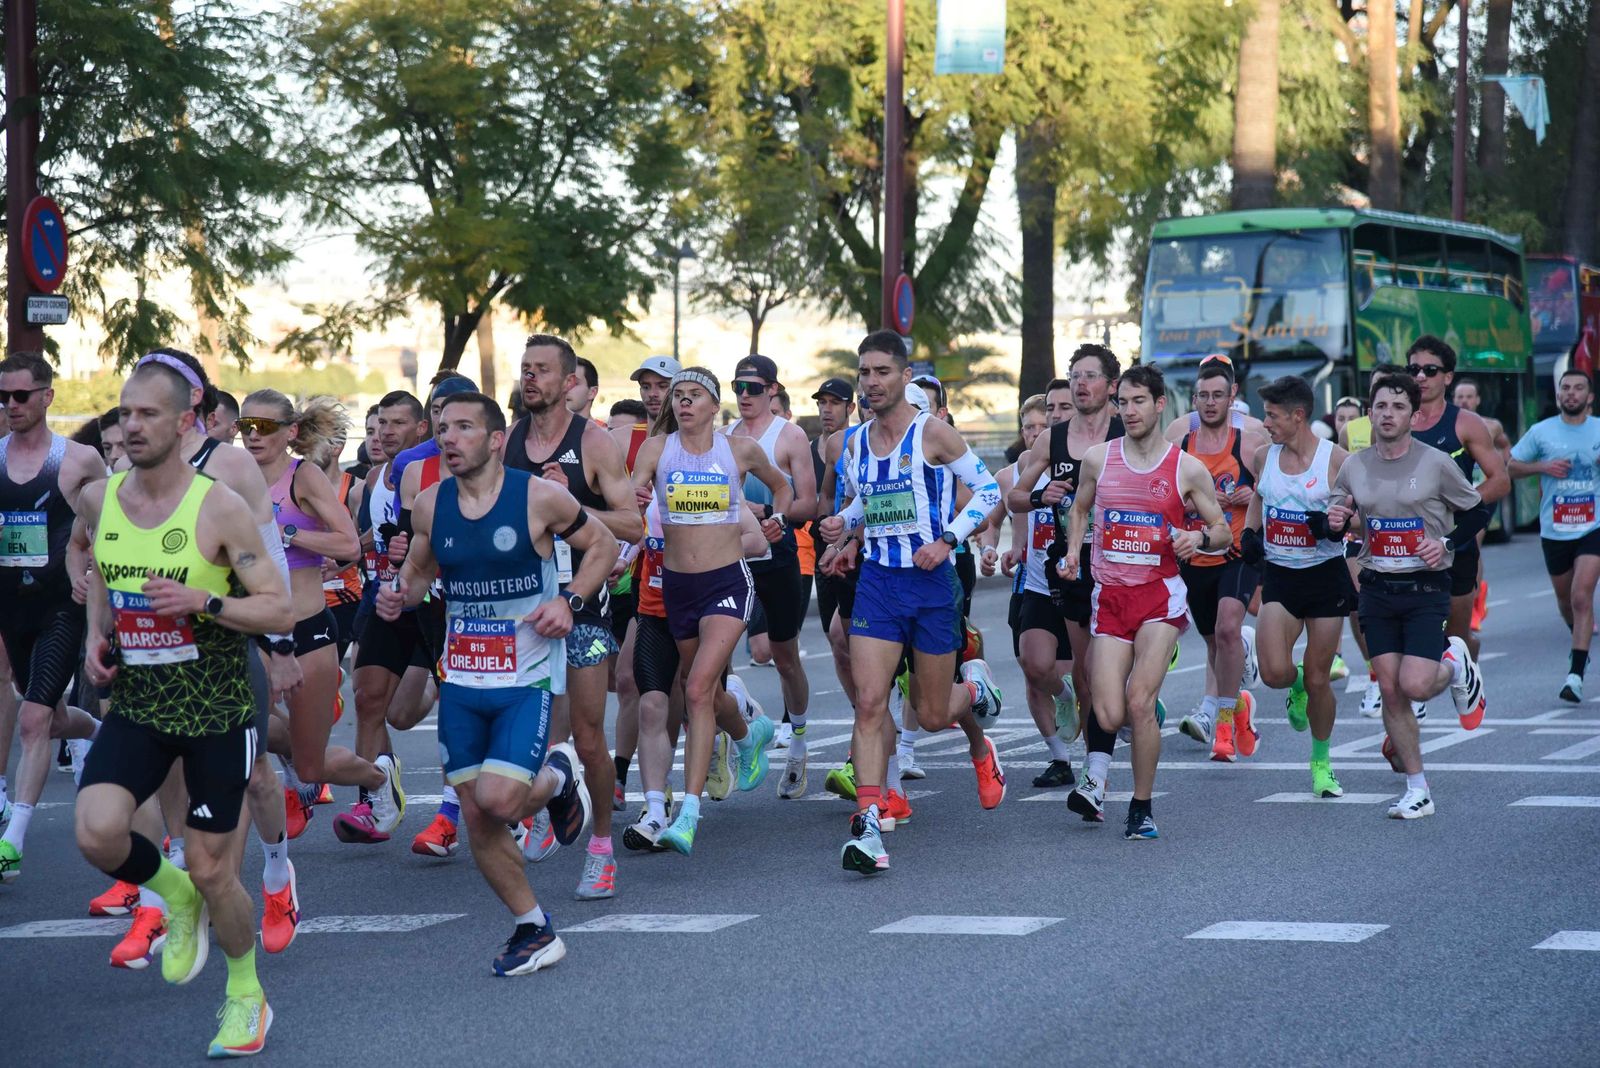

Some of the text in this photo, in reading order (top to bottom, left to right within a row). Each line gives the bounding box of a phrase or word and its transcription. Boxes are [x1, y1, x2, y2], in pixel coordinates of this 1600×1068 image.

[876, 482, 905, 492] ZURICH
[686, 490, 708, 498] F-119
[676, 501, 720, 512] MONIKA
[880, 500, 892, 508] 548
[8, 515, 40, 523] ZURICH
[1124, 514, 1156, 523] ZURICH
[1562, 515, 1586, 523] MEHDI
[1384, 521, 1416, 529] ZURICH
[1125, 530, 1138, 538] 814
[1273, 534, 1306, 546] JUANKI
[8, 542, 27, 554] BEN
[1112, 539, 1151, 552] SERGIO
[1384, 545, 1410, 556] PAUL
[450, 574, 538, 597] MOSQUETEROS
[136, 617, 156, 628] 830
[467, 623, 506, 632] ZURICH
[120, 630, 184, 648] MARCOS
[470, 642, 486, 652] 815
[450, 654, 514, 670] OREJUELA
